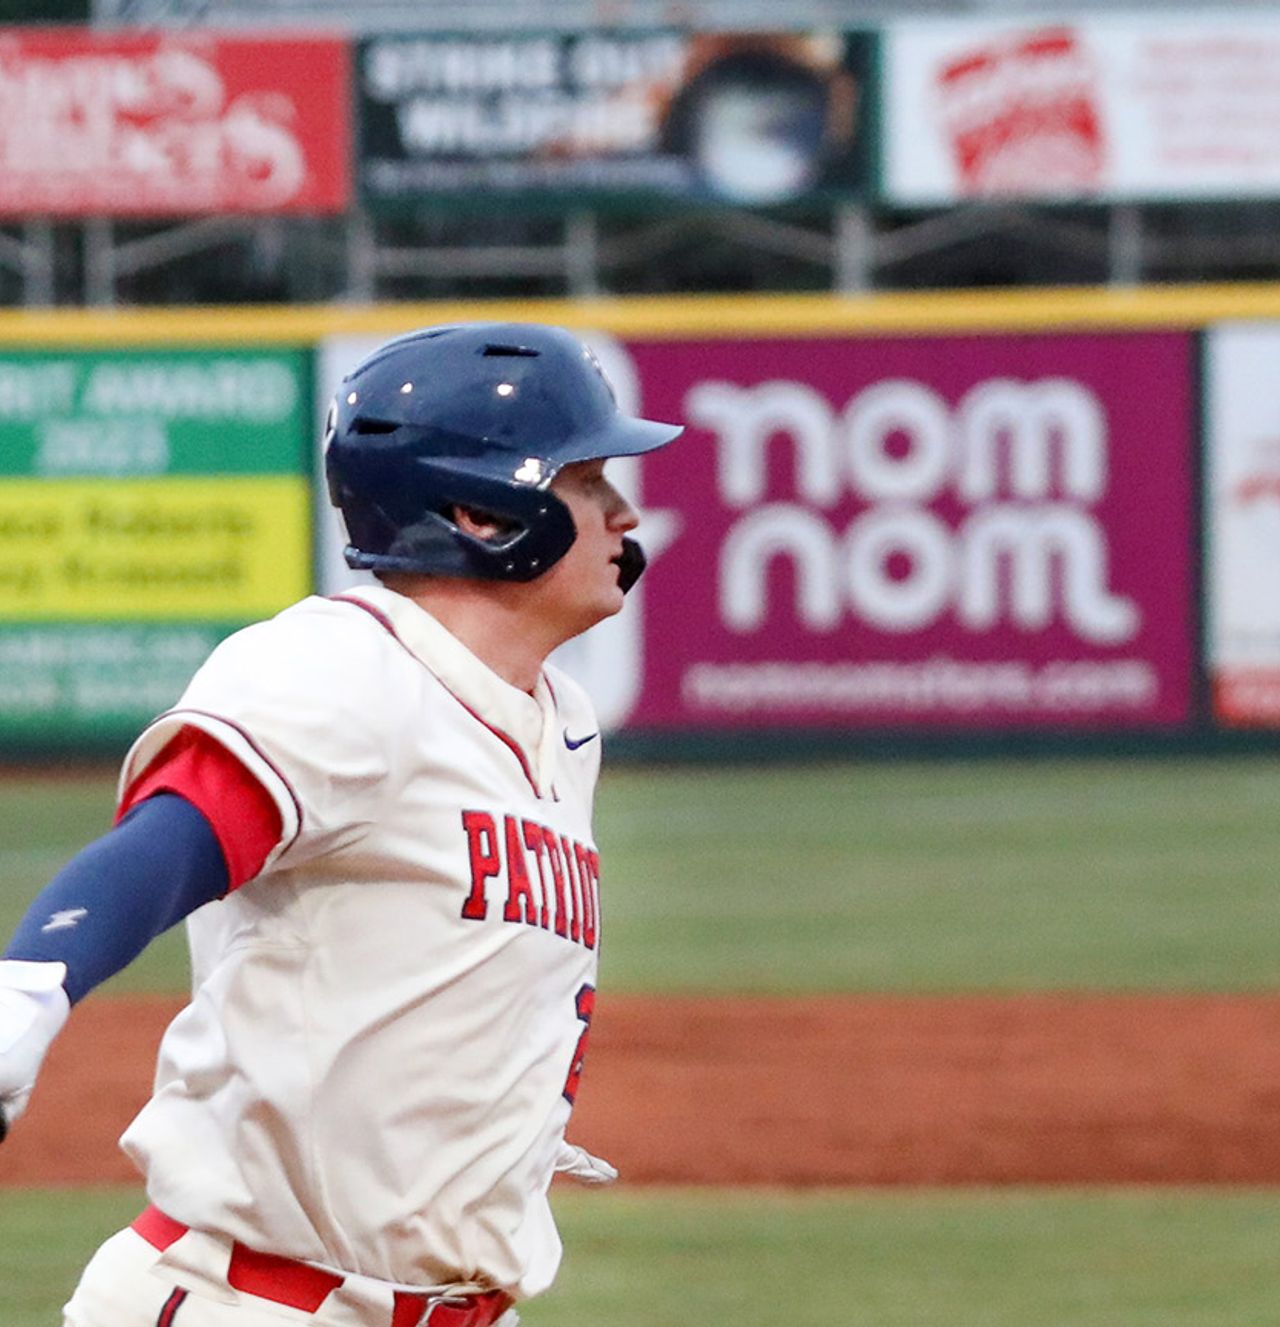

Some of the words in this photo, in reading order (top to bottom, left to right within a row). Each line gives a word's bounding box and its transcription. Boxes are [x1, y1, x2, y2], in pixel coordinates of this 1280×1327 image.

[367, 40, 562, 94] STRIKE
[572, 38, 690, 92] OUT
[86, 362, 297, 420] AWARD
[683, 378, 1106, 507] nom
[720, 503, 1139, 645] nom
